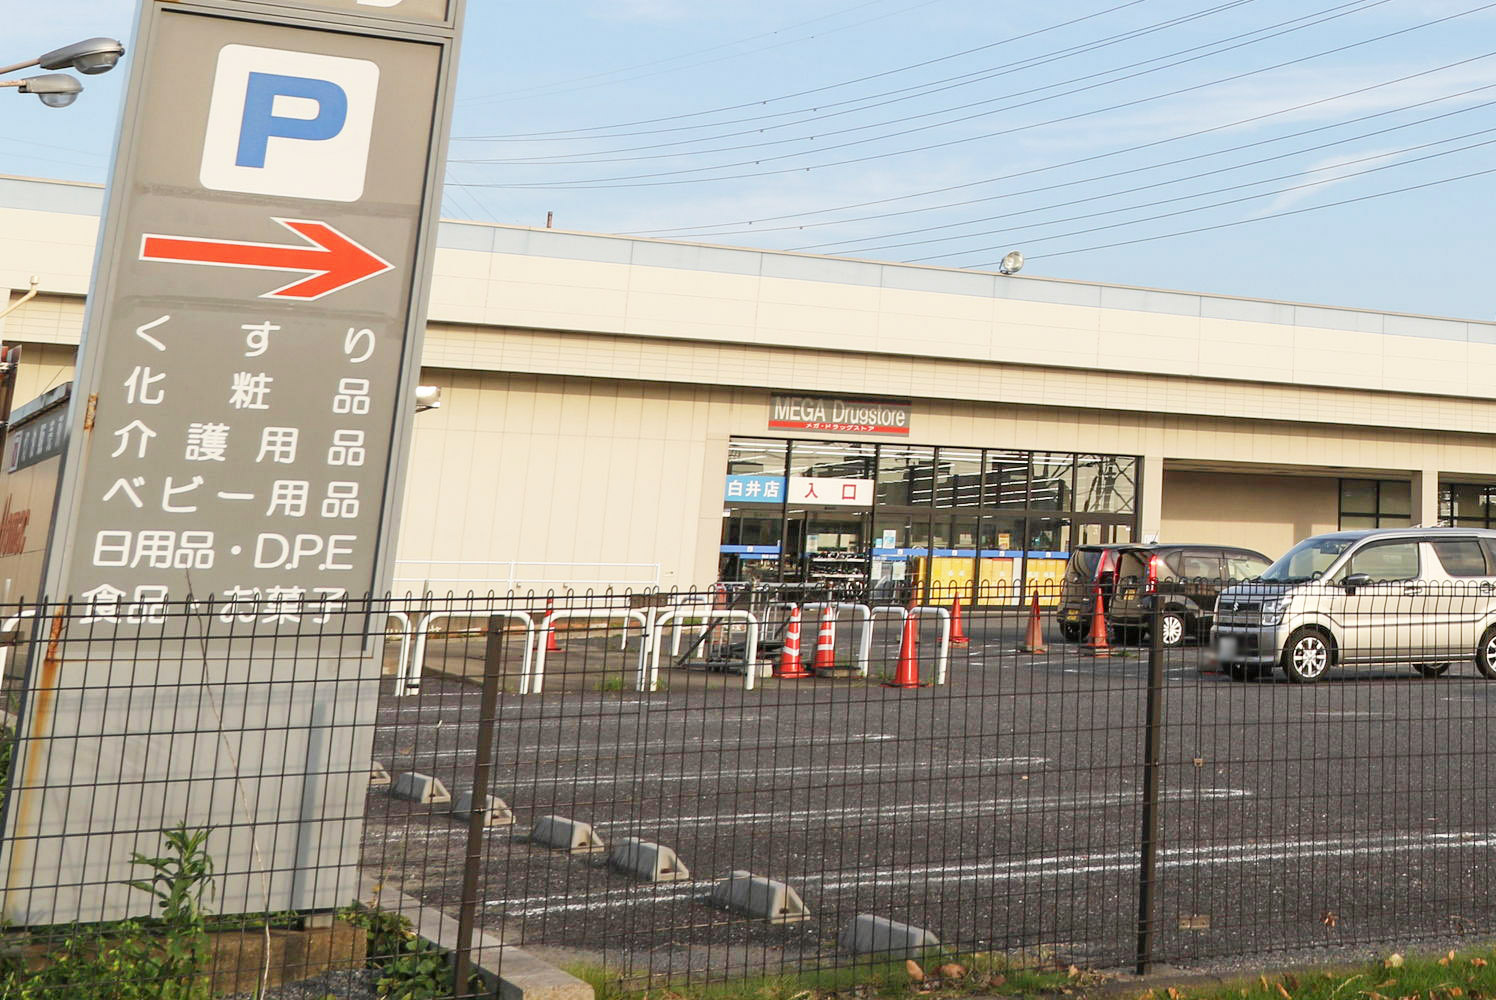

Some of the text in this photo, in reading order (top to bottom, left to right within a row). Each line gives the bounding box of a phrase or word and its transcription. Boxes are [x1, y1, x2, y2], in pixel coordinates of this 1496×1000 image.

[235, 71, 348, 168] P
[136, 315, 376, 363] くすり
[124, 366, 370, 415] 化粧品
[774, 396, 905, 426] MEGA Drugstore
[111, 420, 365, 467] 介護用品
[103, 476, 359, 519] ベビー用品
[727, 480, 780, 497] 白井店
[804, 483, 857, 500] 入口
